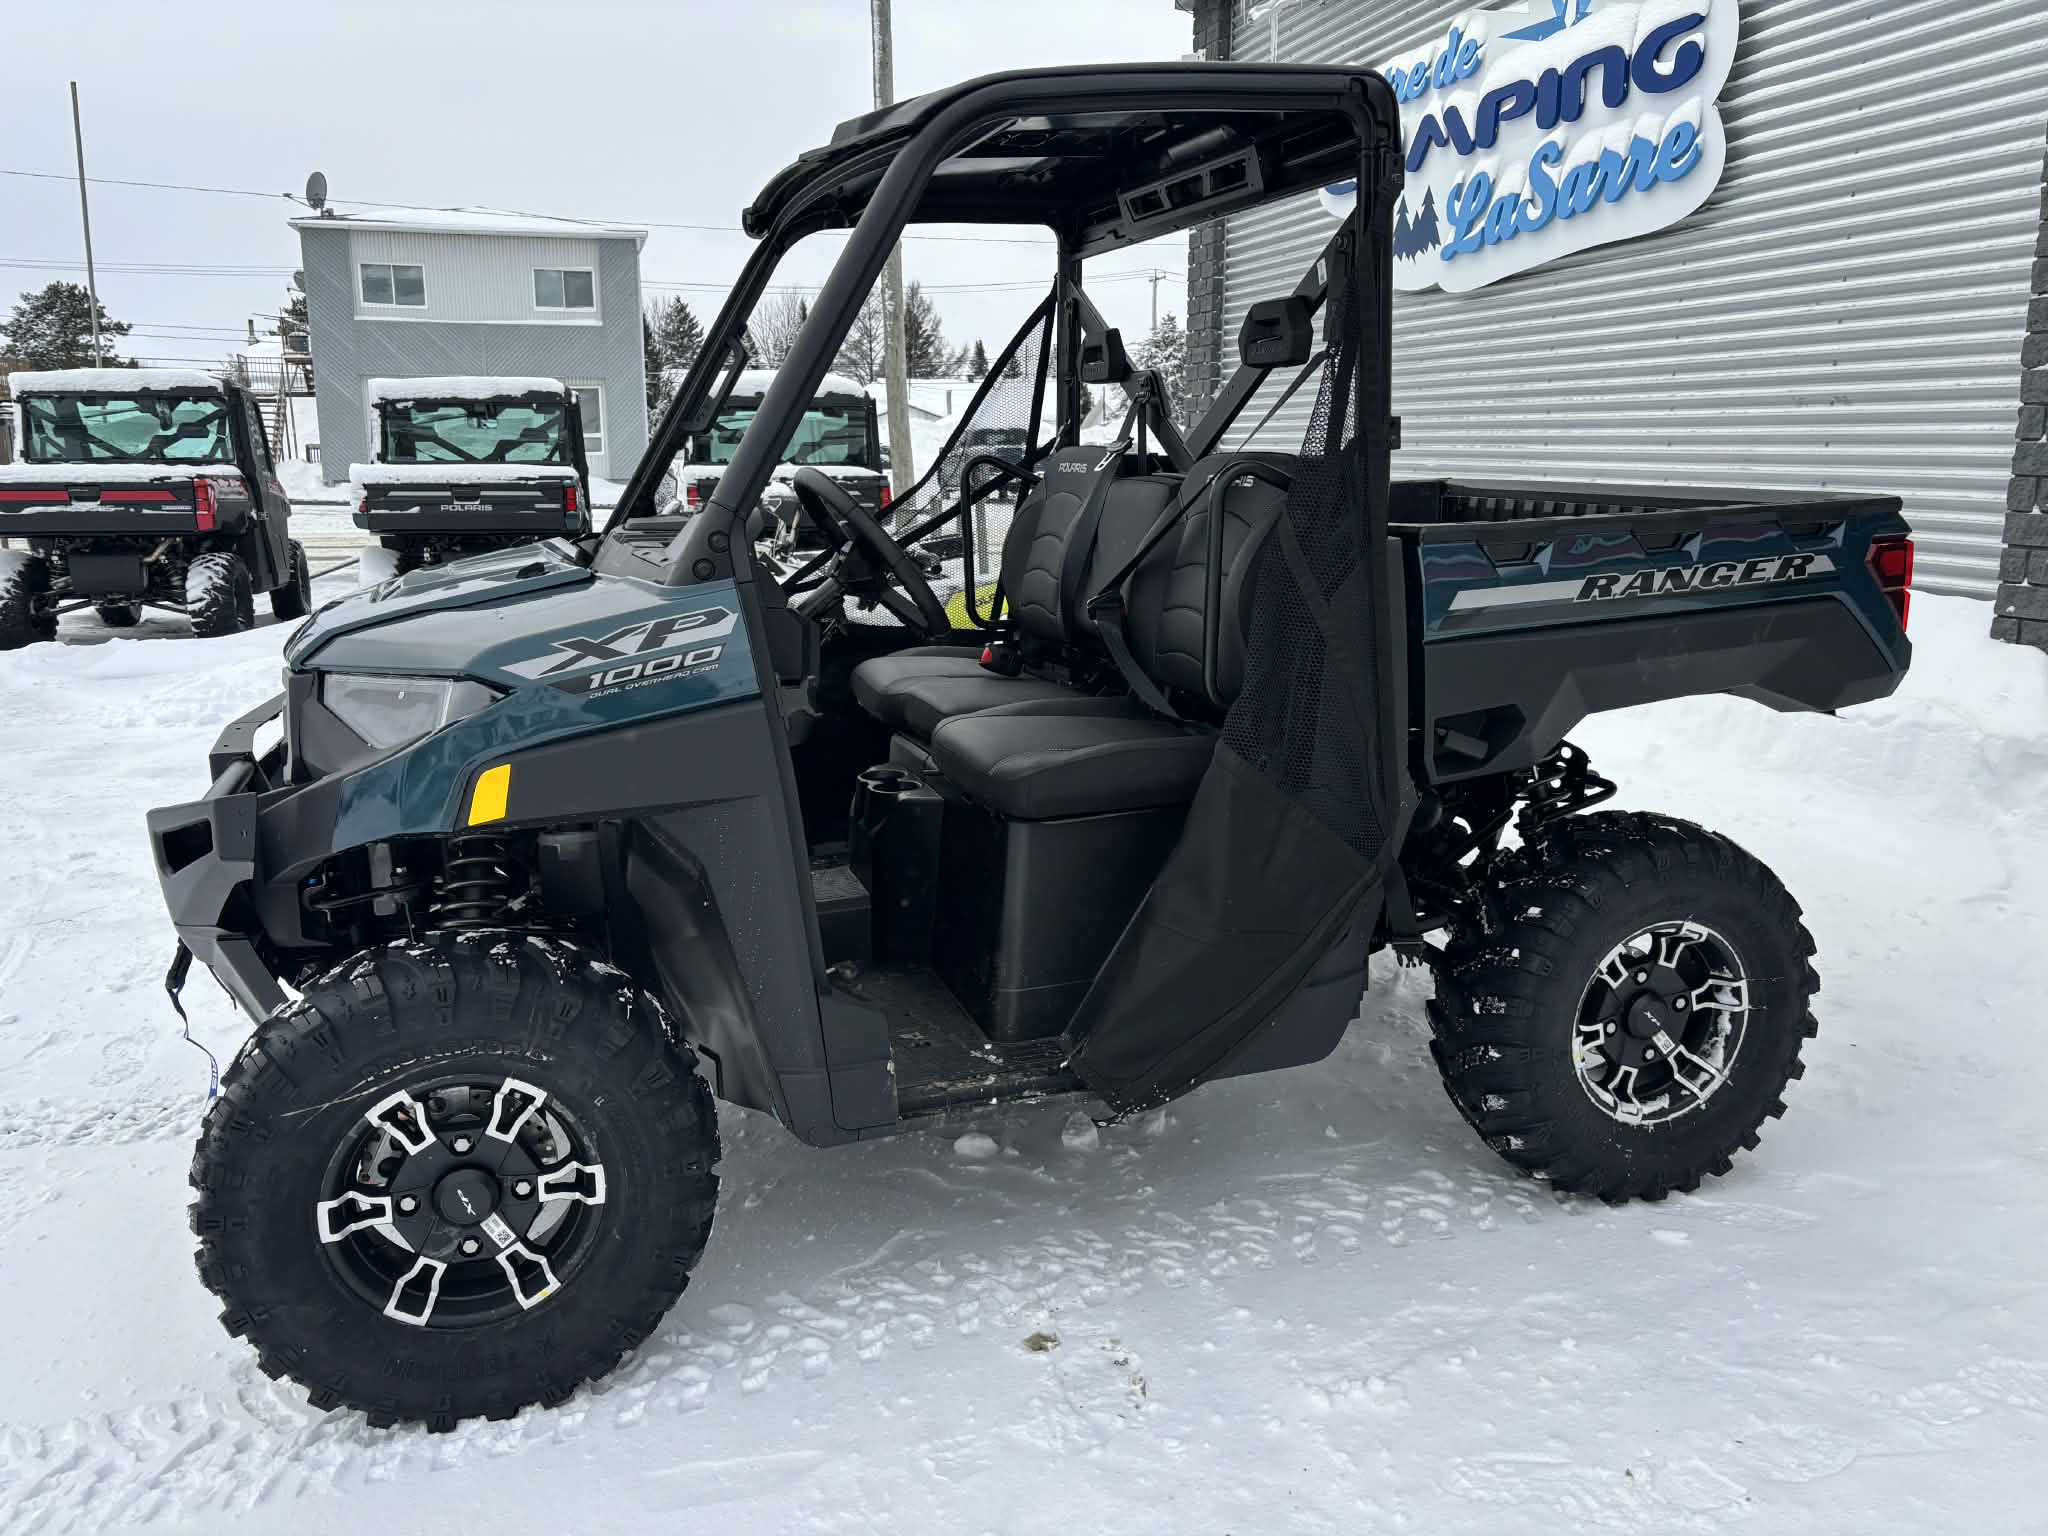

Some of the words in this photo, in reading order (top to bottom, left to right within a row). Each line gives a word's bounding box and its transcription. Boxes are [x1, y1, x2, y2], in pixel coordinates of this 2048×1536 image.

[1433, 26, 1481, 89] de
[1405, 12, 1707, 173] MPING
[1439, 121, 1702, 261] LaSarre
[440, 504, 493, 512] POLARIS
[1573, 552, 1817, 602] RANGER
[536, 606, 733, 677] XP
[589, 645, 723, 689] 1000
[589, 686, 622, 699] DUAL
[625, 670, 690, 690] OVERHEAD
[693, 663, 720, 675] CAM
